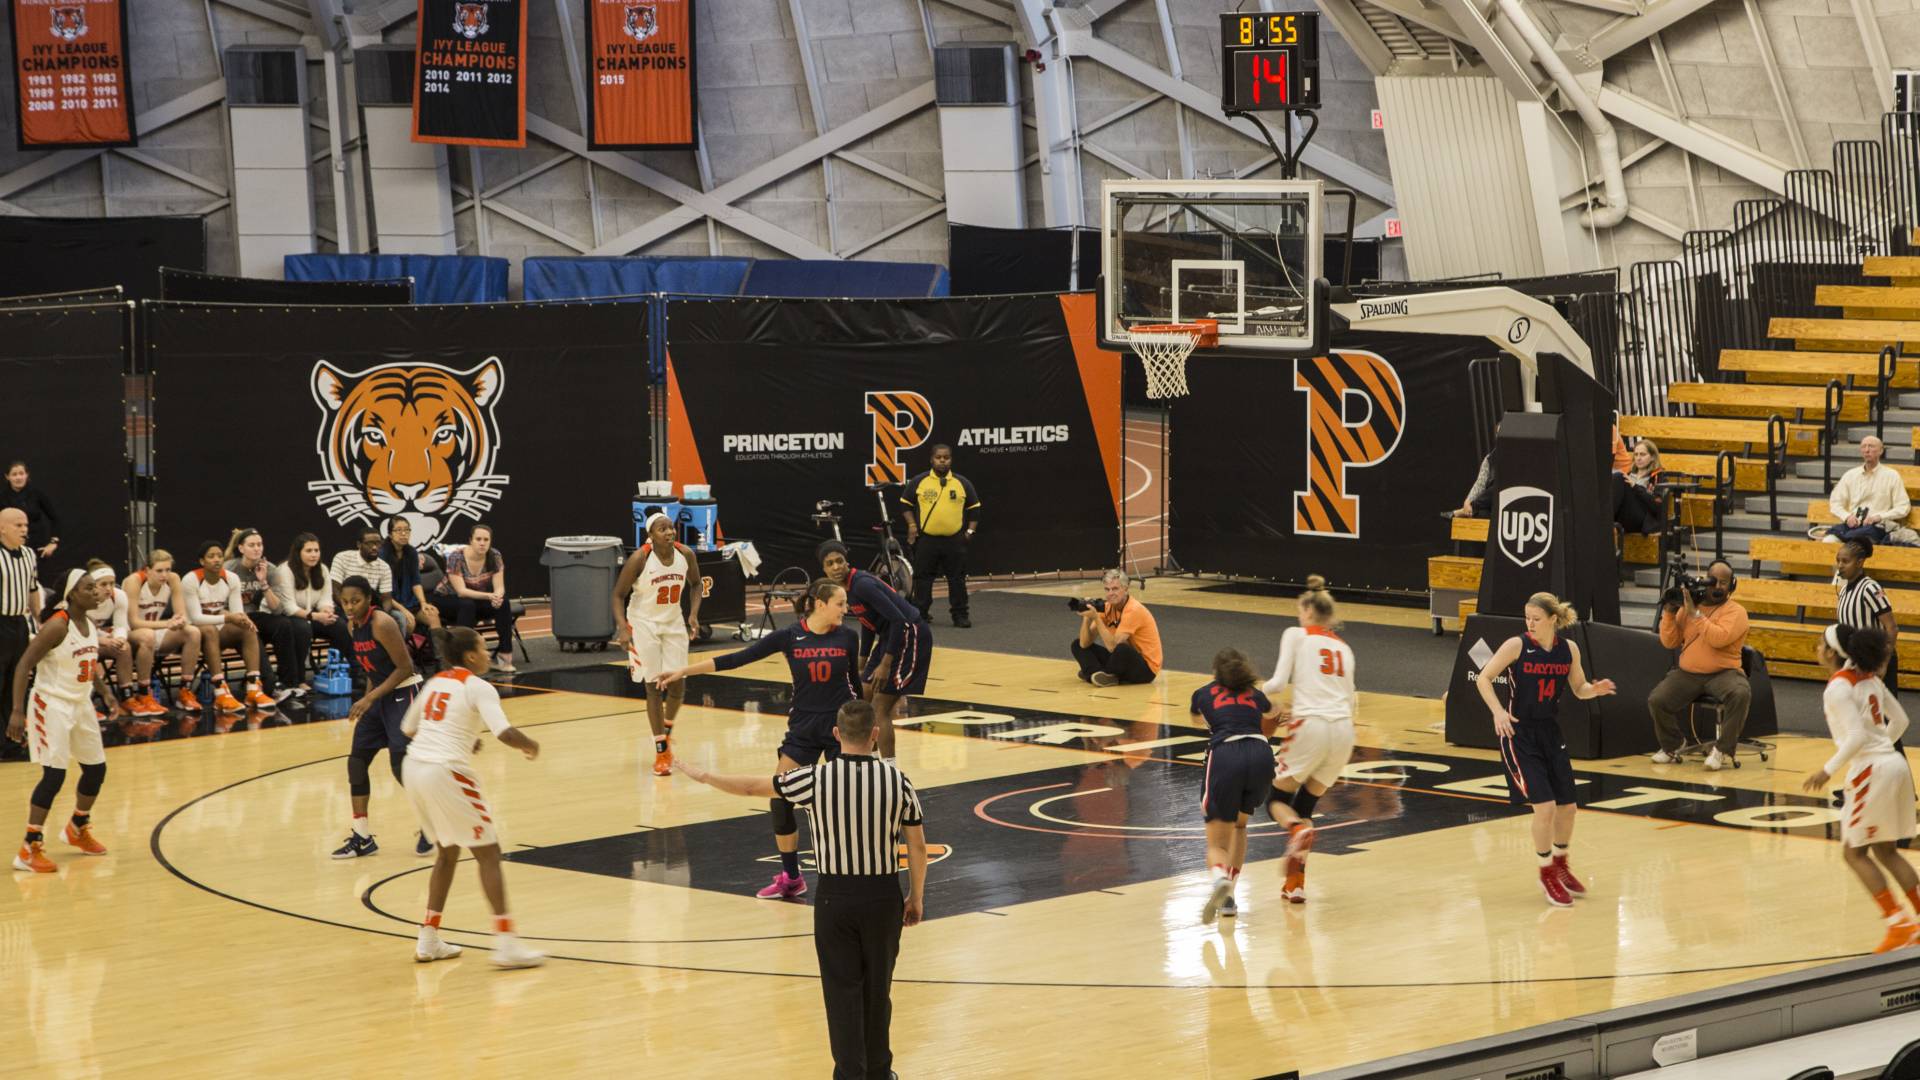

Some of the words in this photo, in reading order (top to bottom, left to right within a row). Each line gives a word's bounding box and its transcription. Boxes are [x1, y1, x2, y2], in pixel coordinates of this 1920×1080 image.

[33, 45, 52, 55] IVY
[57, 43, 108, 54] LEAGUE
[433, 40, 453, 50] IVY
[457, 41, 506, 53] LEAGUE
[607, 44, 626, 54] IVY
[630, 43, 676, 54] LEAGUE
[22, 55, 119, 71] CHAMPIONS
[422, 52, 516, 69] CHAMPIONS
[597, 56, 687, 70] CHAMPIONS
[425, 70, 450, 80] 2010
[456, 71, 482, 82] 2011
[487, 73, 512, 84] 2012
[600, 75, 625, 85] 2015
[1253, 54, 1286, 104] 14
[424, 82, 450, 93] 2014
[93, 98, 118, 109] 2011
[1373, 113, 1383, 128] EX
[1388, 221, 1401, 235] EXI
[1360, 299, 1408, 319] SPALDING
[723, 432, 844, 452] PRINCETON
[865, 391, 934, 486] P
[958, 425, 1069, 446] ATHLETICS
[1294, 349, 1406, 538] P
[651, 573, 685, 586] PRINCETON
[701, 576, 714, 598] P
[656, 585, 681, 605] 20
[793, 648, 847, 659] DAYTON
[1319, 648, 1345, 677] 31
[1523, 662, 1569, 675] DAYTON
[808, 661, 832, 683] 10
[1468, 671, 1508, 685] Rense
[1210, 685, 1257, 709] 22
[1537, 678, 1556, 702] 14
[1868, 694, 1883, 725] 2
